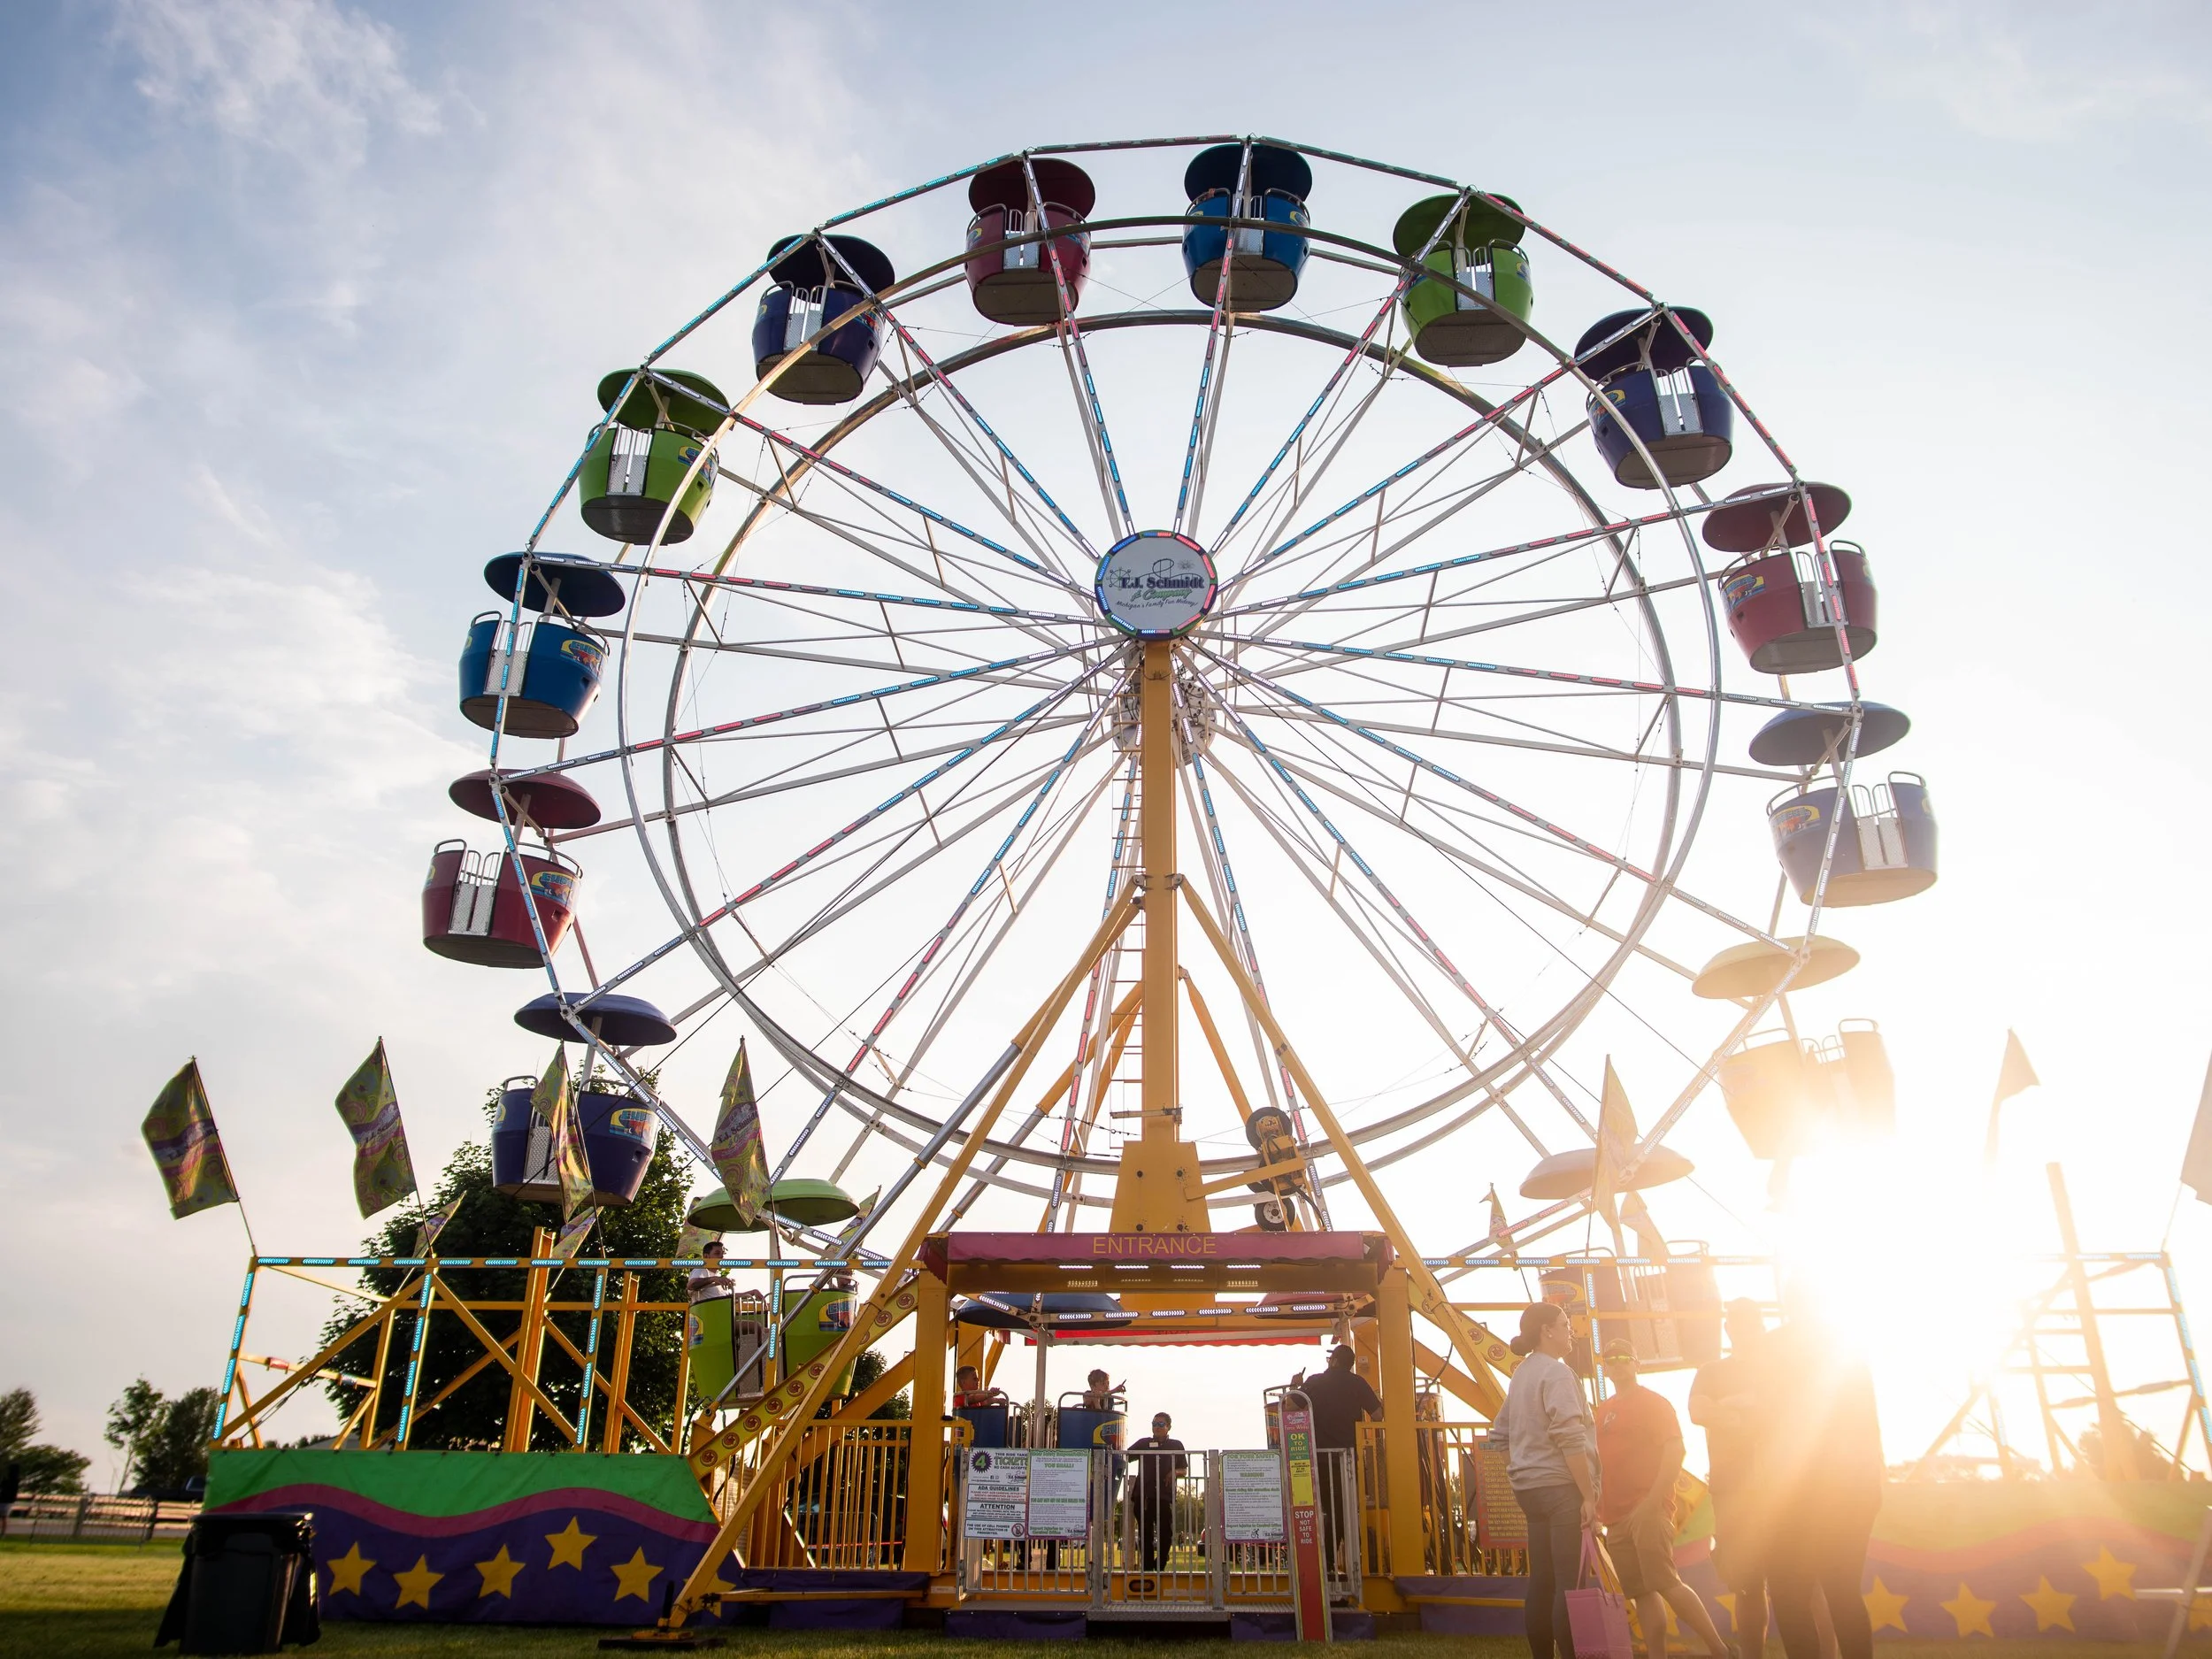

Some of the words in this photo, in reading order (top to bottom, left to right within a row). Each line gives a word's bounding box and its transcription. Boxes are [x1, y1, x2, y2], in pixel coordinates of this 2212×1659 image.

[1121, 577, 1144, 589] T.J.
[1147, 576, 1205, 589] Schmidt
[1142, 588, 1193, 602] Company
[1145, 600, 1165, 609] Family
[1093, 1236, 1217, 1255] ENTRANCE
[975, 1454, 987, 1469] 4
[1294, 1510, 1314, 1519] STOP
